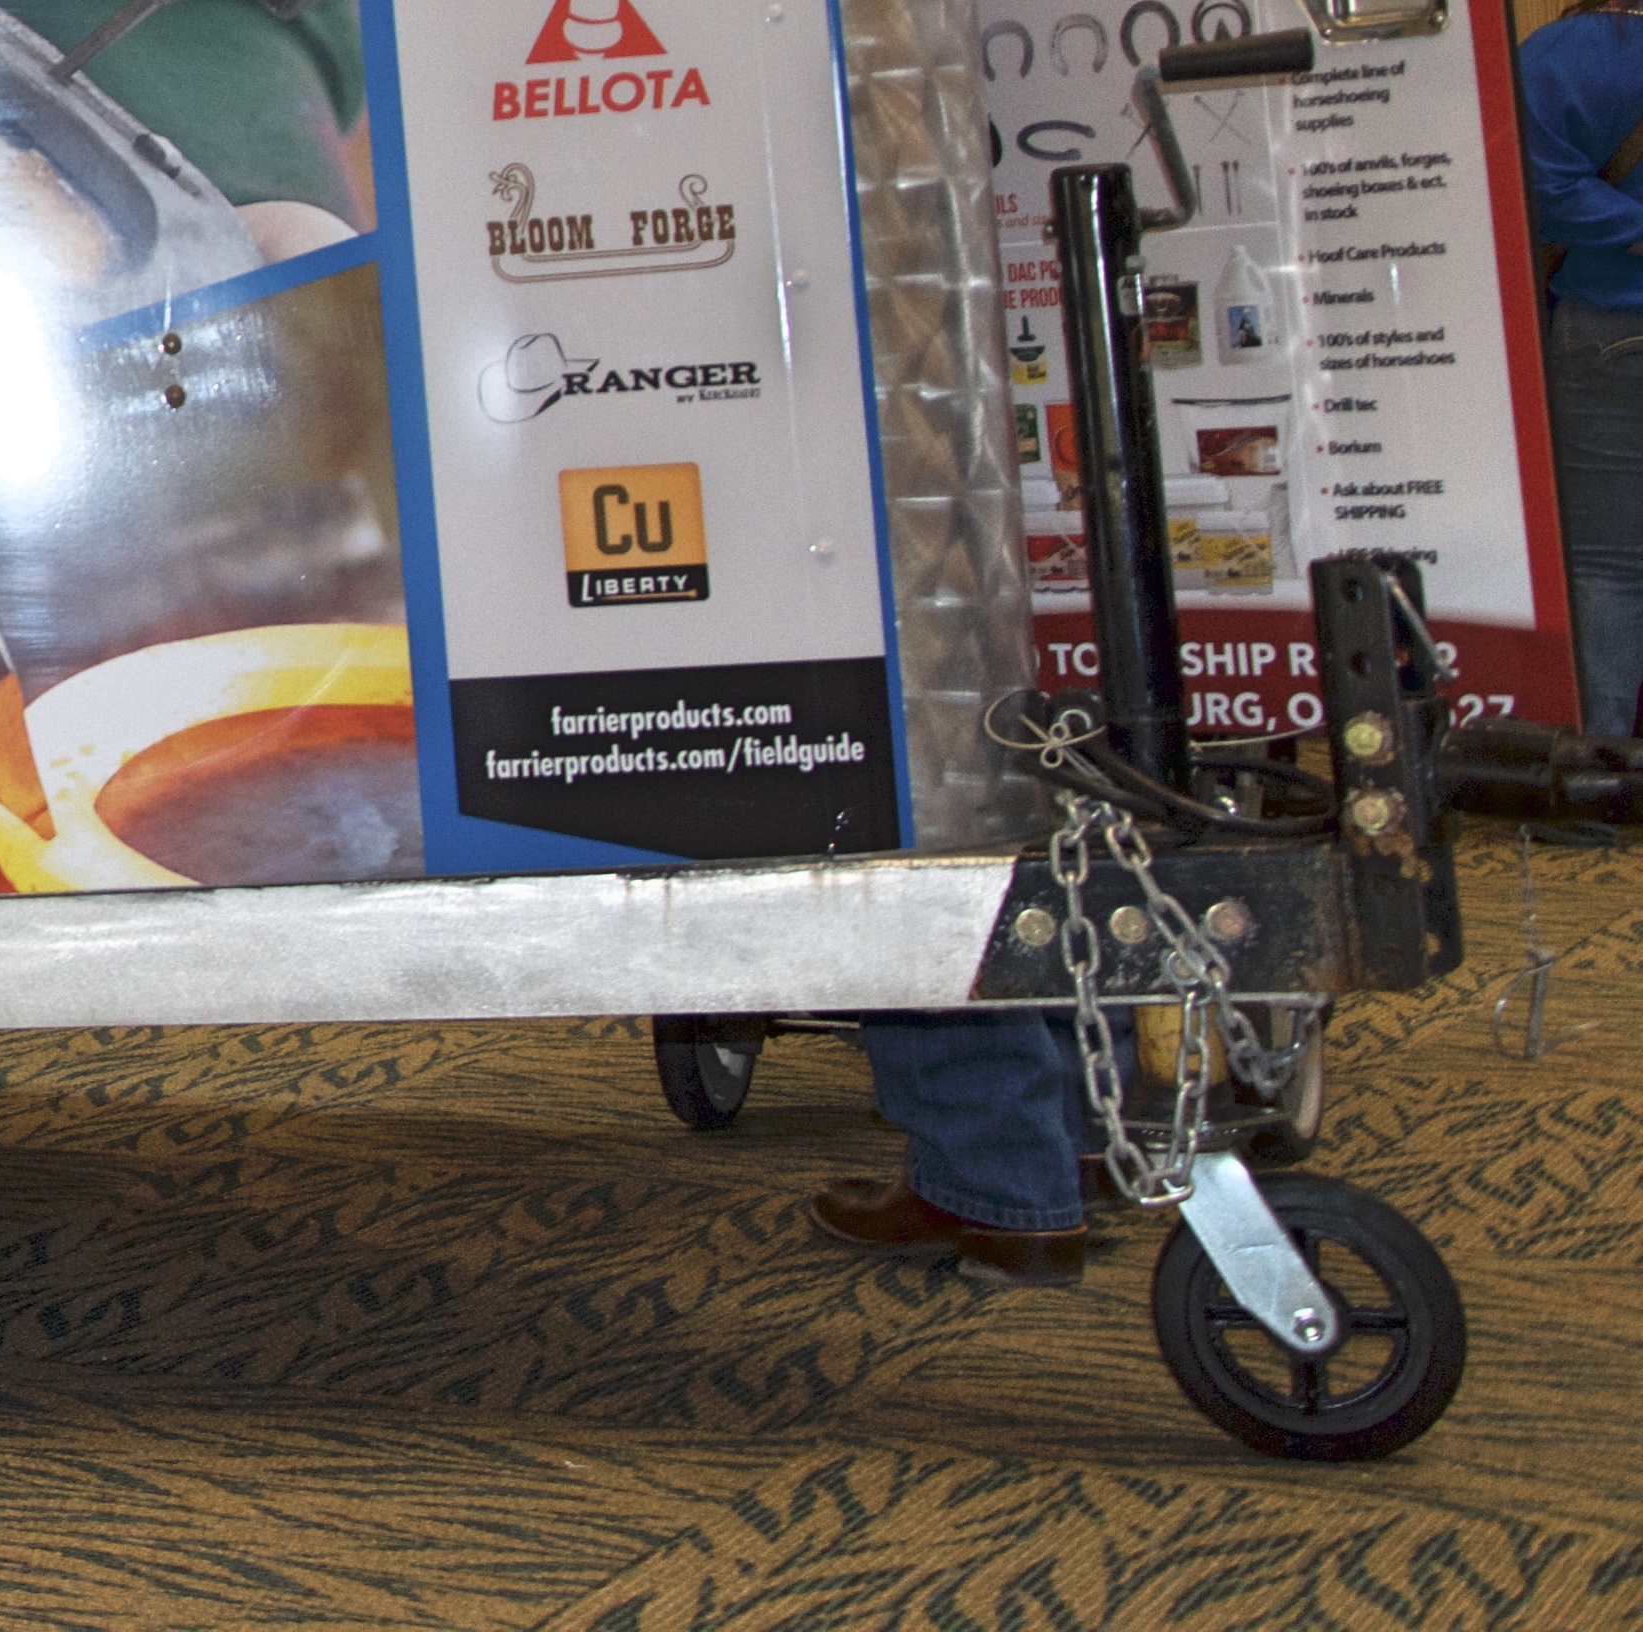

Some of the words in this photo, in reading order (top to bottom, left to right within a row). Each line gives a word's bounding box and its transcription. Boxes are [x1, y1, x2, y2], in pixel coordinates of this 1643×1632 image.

[1361, 64, 1389, 79] line
[1390, 59, 1407, 76] of
[492, 67, 712, 122] BELLOTA
[1293, 87, 1391, 109] horseshoeing
[1295, 114, 1355, 133] supplies
[1302, 179, 1360, 200] shoeing
[1361, 176, 1405, 195] boxes
[1406, 175, 1418, 190] &
[1304, 208, 1319, 222] in
[1320, 204, 1359, 221] stock
[487, 213, 595, 257] BLOOM
[629, 203, 736, 247] FORGE
[1308, 245, 1345, 264] Hoof
[1345, 244, 1379, 261] Care
[1380, 240, 1447, 259] Products
[1312, 287, 1376, 306] Minerals
[1317, 331, 1354, 349] 100's
[1355, 330, 1371, 346] of
[1371, 327, 1414, 348] styles
[1415, 325, 1446, 344] and
[1319, 355, 1354, 371] sizes
[1355, 353, 1372, 369] of
[1372, 350, 1456, 369] horseshoes
[561, 361, 761, 396] RANGER
[1324, 396, 1355, 414] Drill
[1328, 439, 1383, 456] Borium
[1332, 482, 1360, 498] Ask
[1361, 481, 1406, 497] about
[1407, 479, 1446, 496] FREE
[592, 482, 675, 556] Cu
[1334, 503, 1407, 520] SHIPPING
[580, 571, 690, 603] LIBERTY
[551, 699, 793, 741] farrierproducts.com
[485, 731, 866, 784] farrierproducts.com/fieldguide
